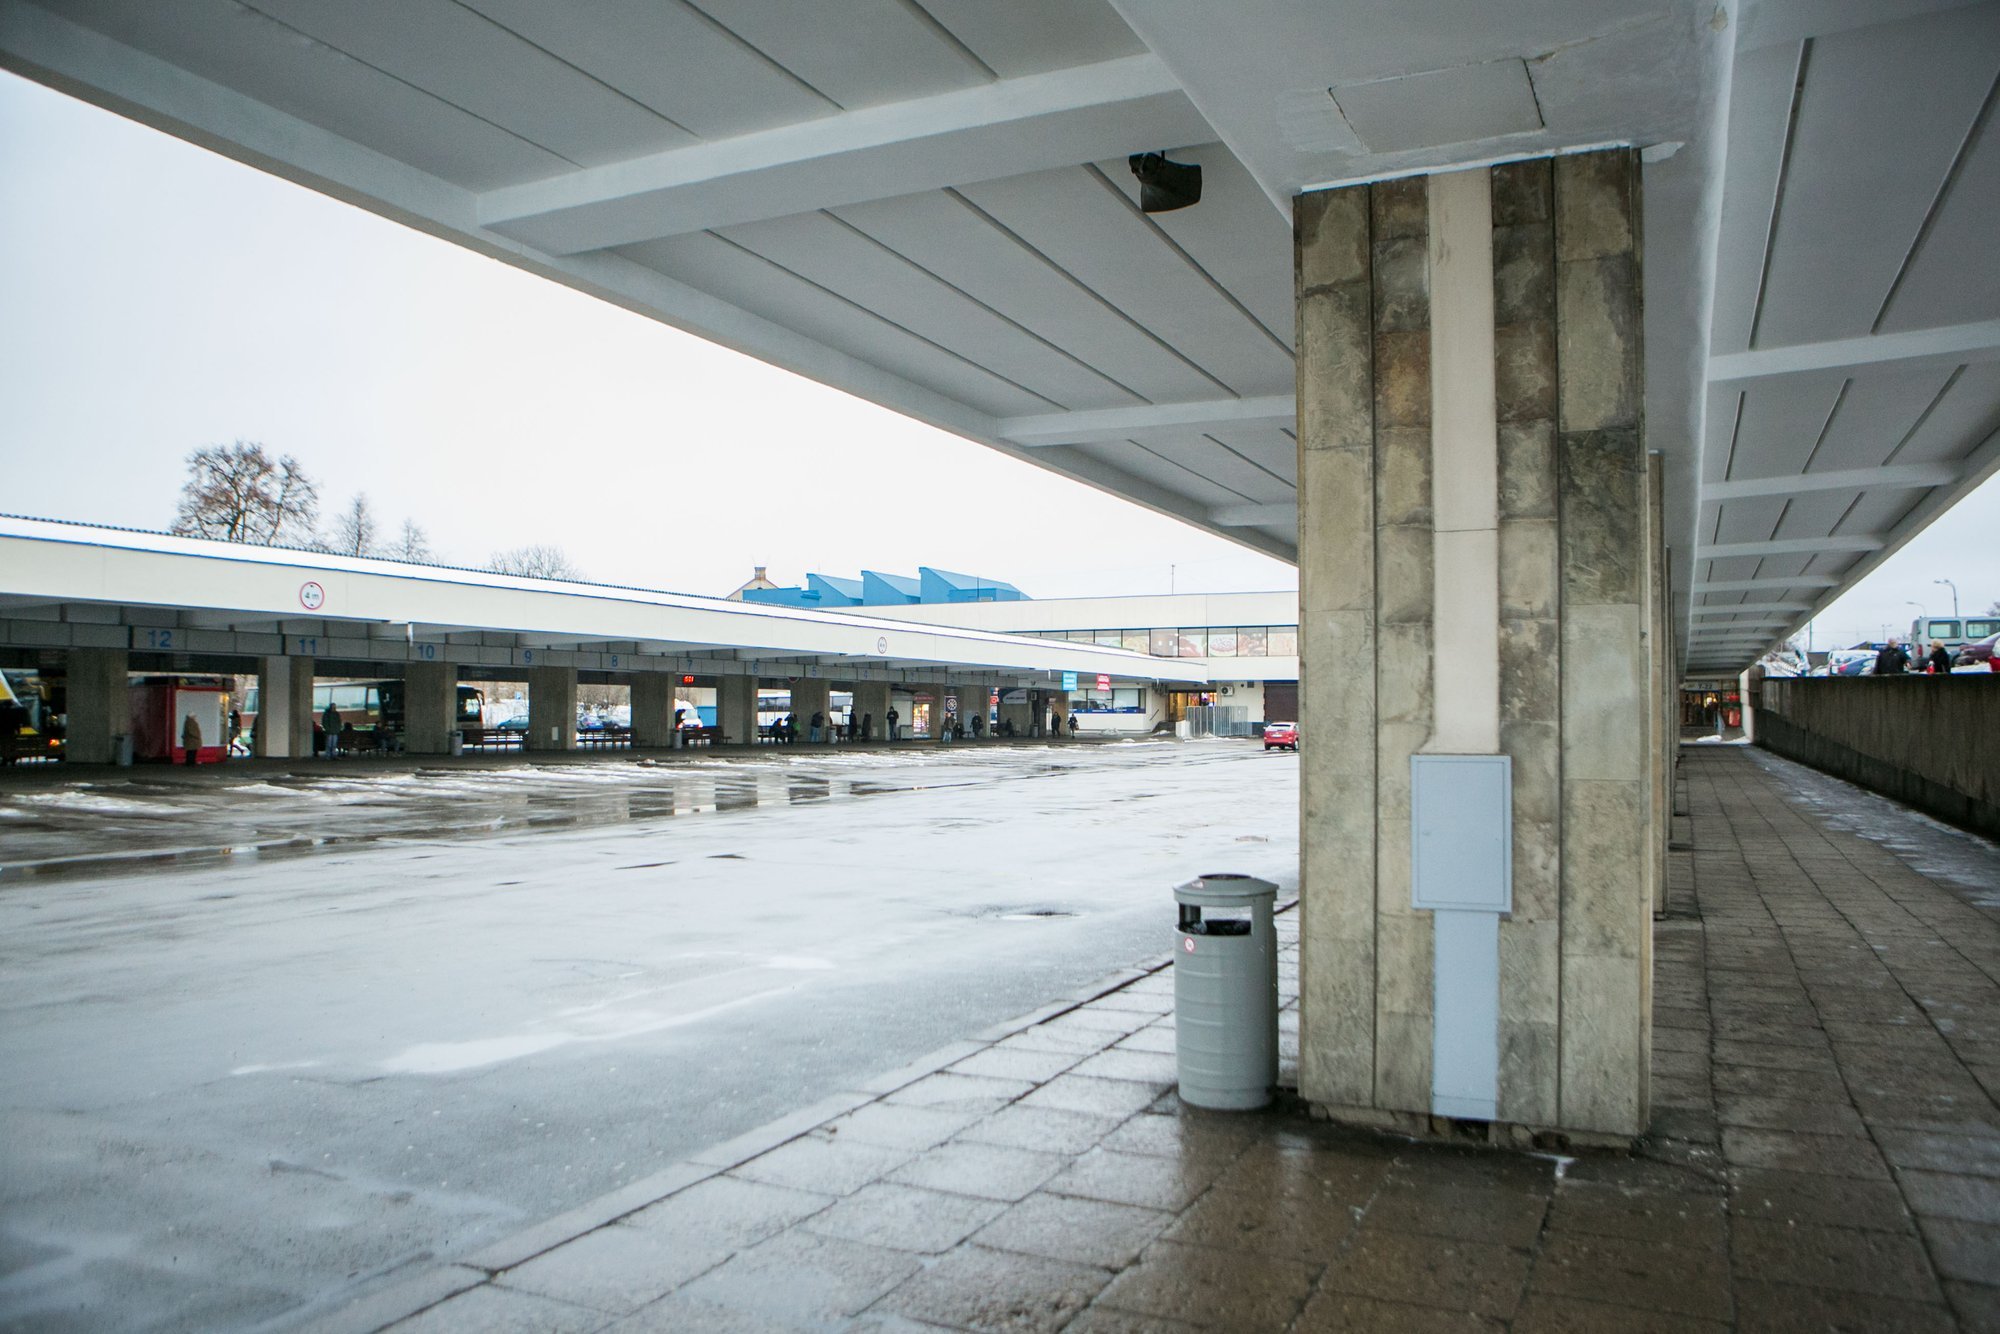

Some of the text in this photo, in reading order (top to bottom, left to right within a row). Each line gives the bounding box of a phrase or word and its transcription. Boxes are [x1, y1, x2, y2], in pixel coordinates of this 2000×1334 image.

[148, 631, 172, 648] 12
[298, 638, 317, 654] 11
[417, 644, 435, 659] 10
[524, 650, 532, 663] 9
[611, 655, 618, 667] 8
[687, 659, 693, 671] 7
[753, 662, 759, 674] 6
[811, 666, 817, 677] 5
